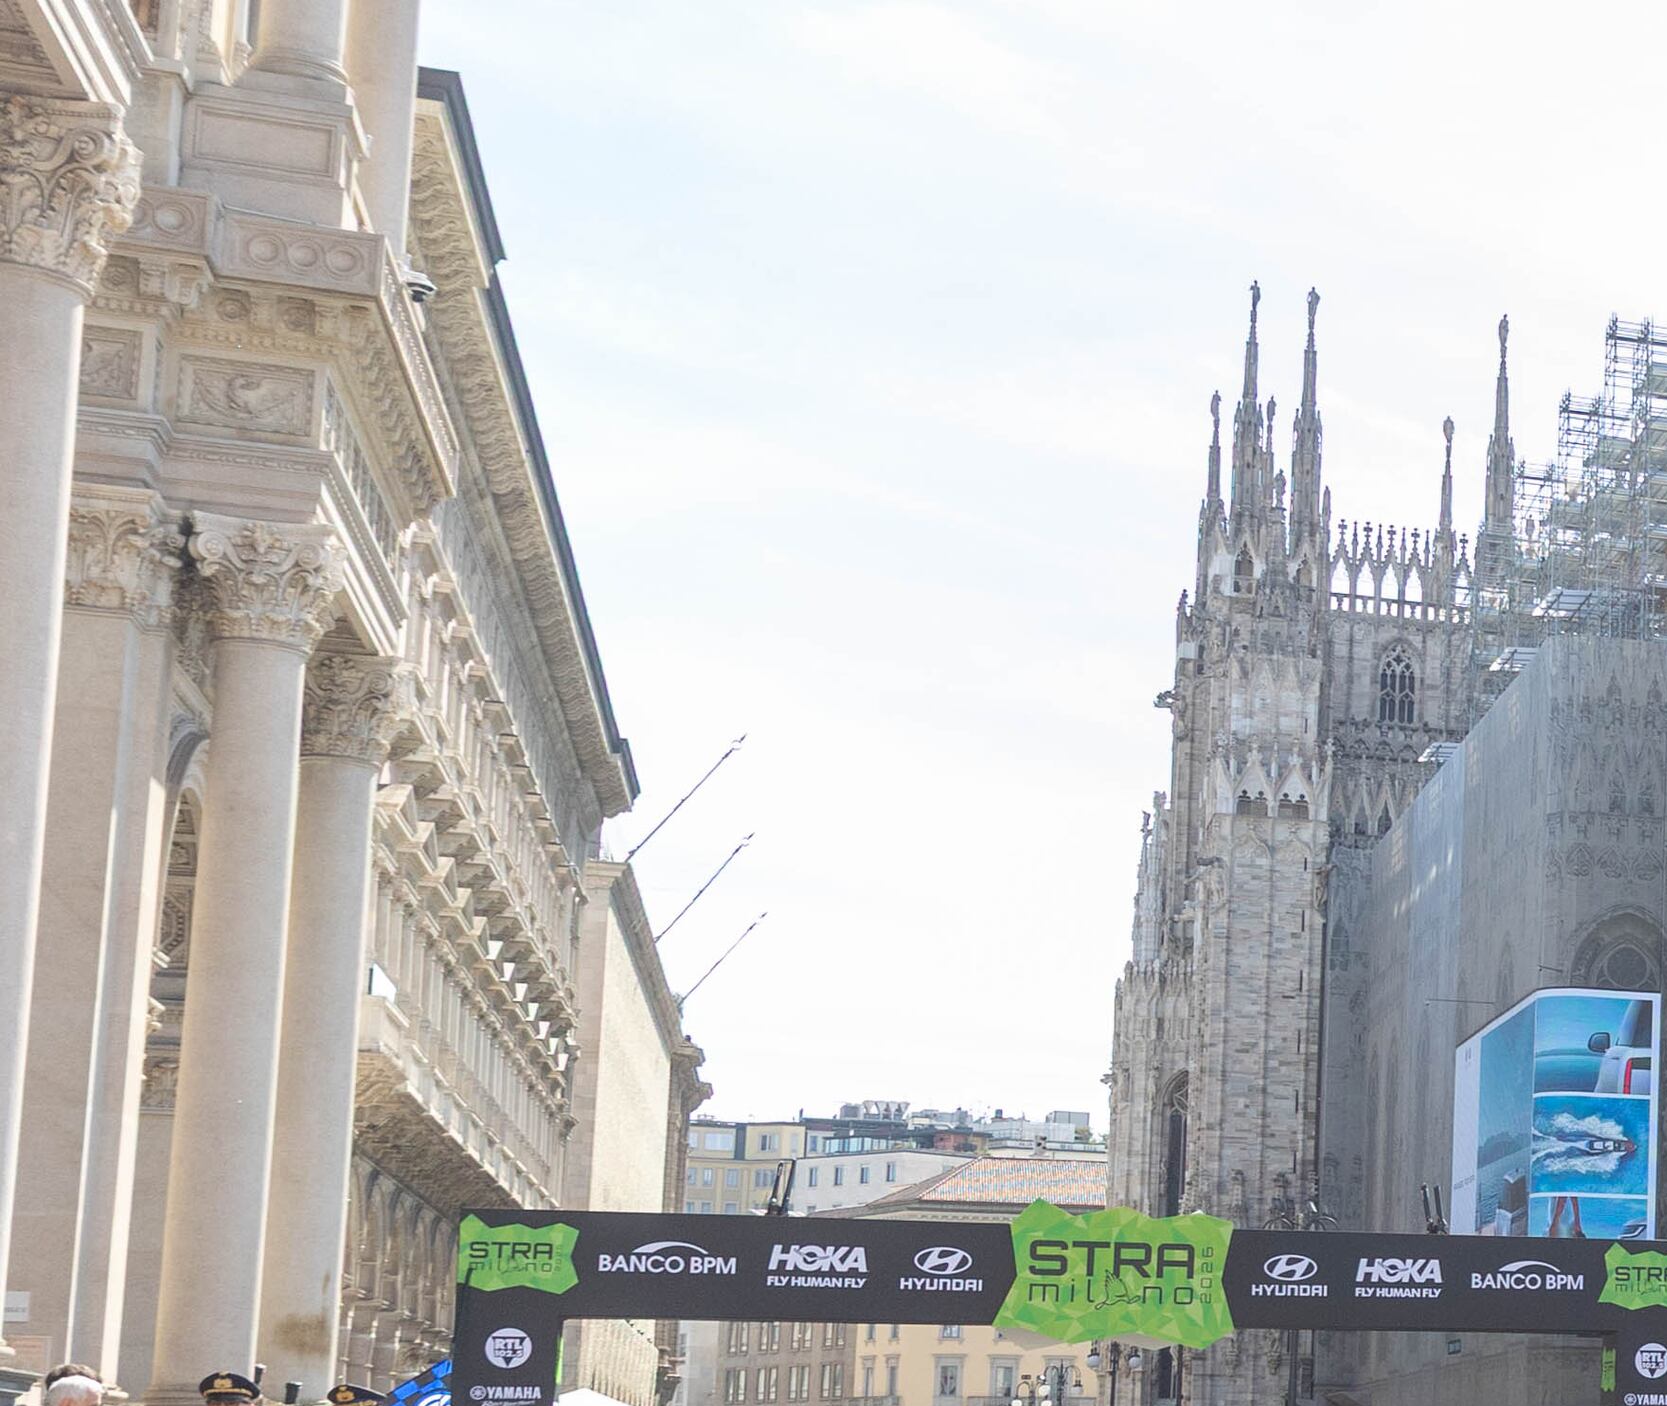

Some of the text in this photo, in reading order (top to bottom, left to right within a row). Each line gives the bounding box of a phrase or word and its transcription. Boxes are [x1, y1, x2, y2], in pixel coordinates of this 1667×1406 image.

[469, 1241, 553, 1260] STRA
[598, 1254, 737, 1275] BANCO BPM
[768, 1244, 868, 1273] HOKA
[1028, 1240, 1195, 1279] STRA
[1200, 1246, 1214, 1304] 2026
[1356, 1258, 1442, 1283] HOKA
[767, 1276, 866, 1288] FLY HUMAN FLY
[900, 1278, 982, 1291] HYUNDAI
[1471, 1273, 1584, 1290] BANCO BPM
[1252, 1284, 1327, 1297] HYUNDAI
[1355, 1288, 1441, 1298] FLY HUMAN FLY
[494, 1339, 523, 1349] RTL
[1641, 1351, 1664, 1362] RTL
[487, 1386, 541, 1399] YAMAHA
